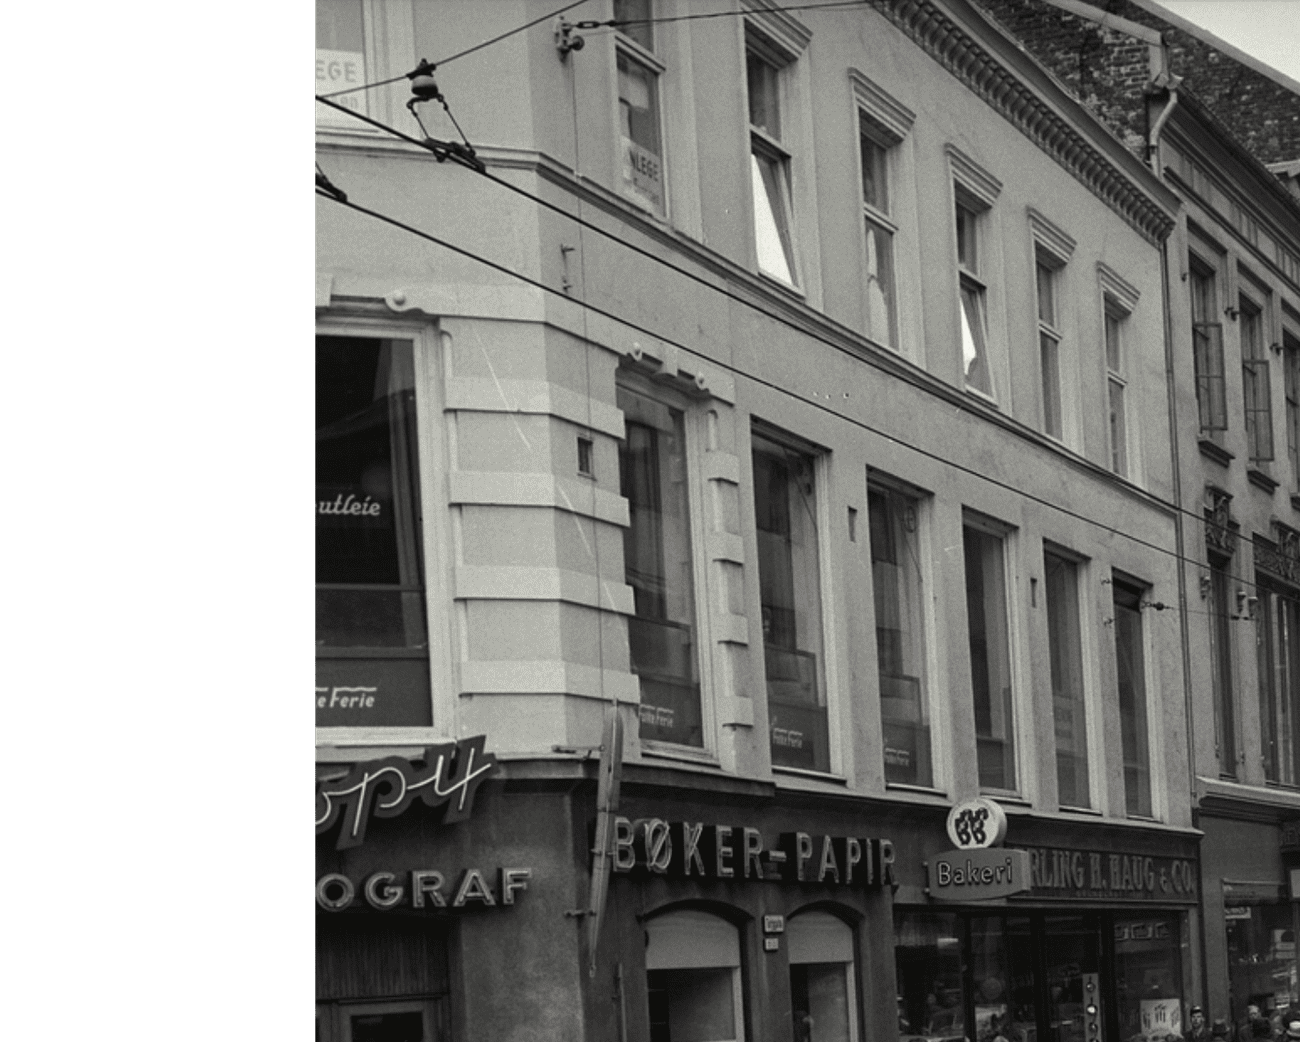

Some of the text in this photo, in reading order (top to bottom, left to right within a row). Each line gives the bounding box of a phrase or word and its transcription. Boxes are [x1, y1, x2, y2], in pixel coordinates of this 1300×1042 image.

[329, 686, 377, 709] Ferie
[938, 857, 1012, 886] Bakeri
[1031, 850, 1085, 888] RLING
[1109, 854, 1155, 891] HAUG
